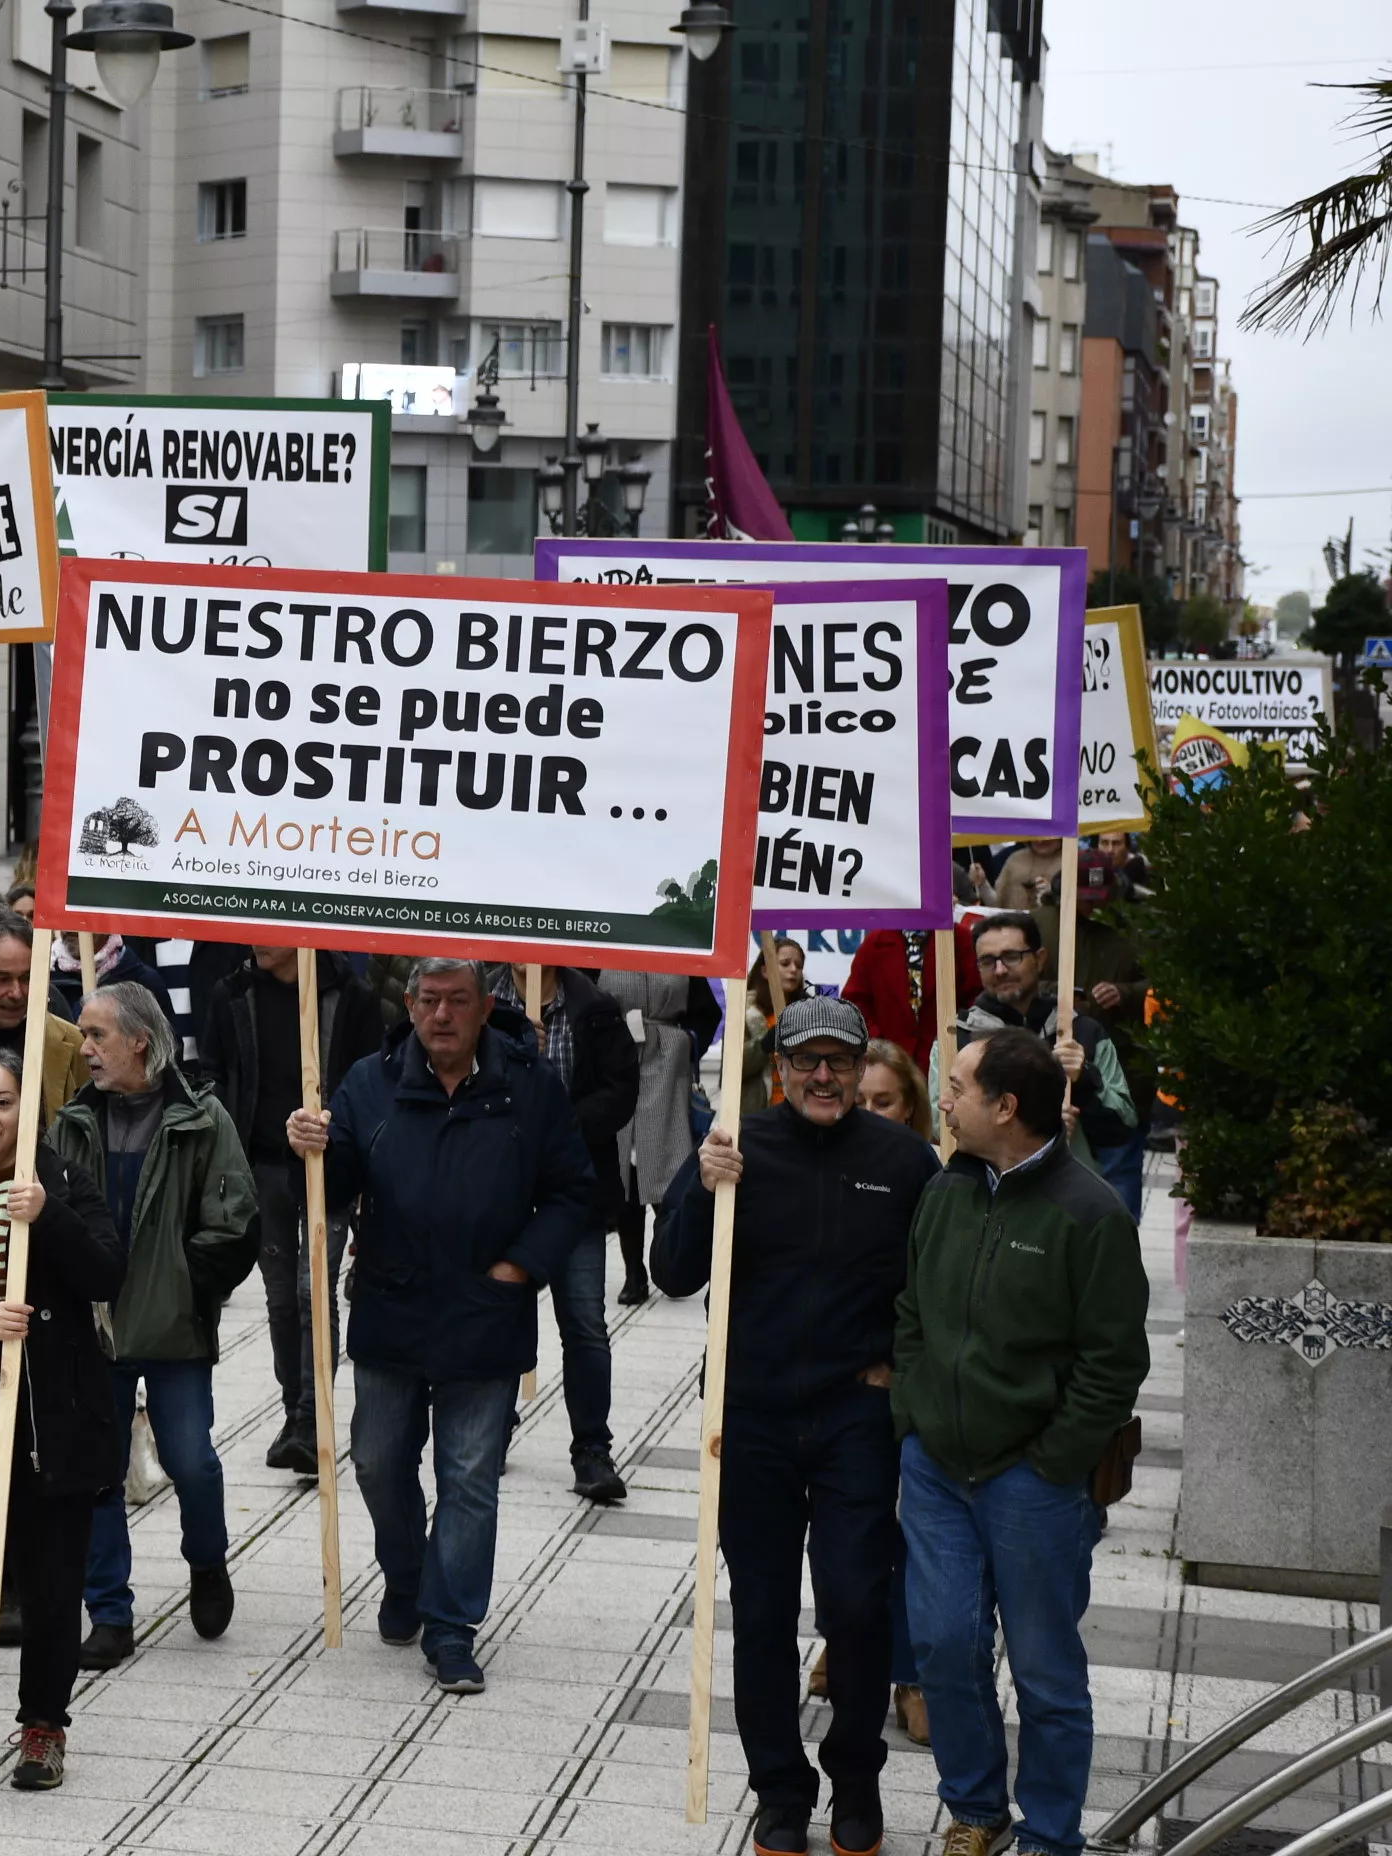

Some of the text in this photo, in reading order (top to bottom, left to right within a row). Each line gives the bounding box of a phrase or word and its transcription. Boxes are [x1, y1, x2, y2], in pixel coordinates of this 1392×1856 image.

[49, 413, 356, 484] NERGÍA RENOVABLE?
[172, 494, 241, 539] SI
[95, 592, 724, 683] NUESTRO BIERZO
[774, 621, 903, 694] NES
[213, 676, 605, 741] no se puede
[138, 731, 588, 816] PROSTITUIR
[174, 808, 441, 861] A Morteira
[753, 827, 864, 898] IÉN?
[171, 852, 439, 889] Árboles Singulares del Bierzo
[162, 892, 611, 934] ASOCIACIÓN PARA LA CONSERVACIÓN DE LOS ÁRBOLES DEL BIERZO
